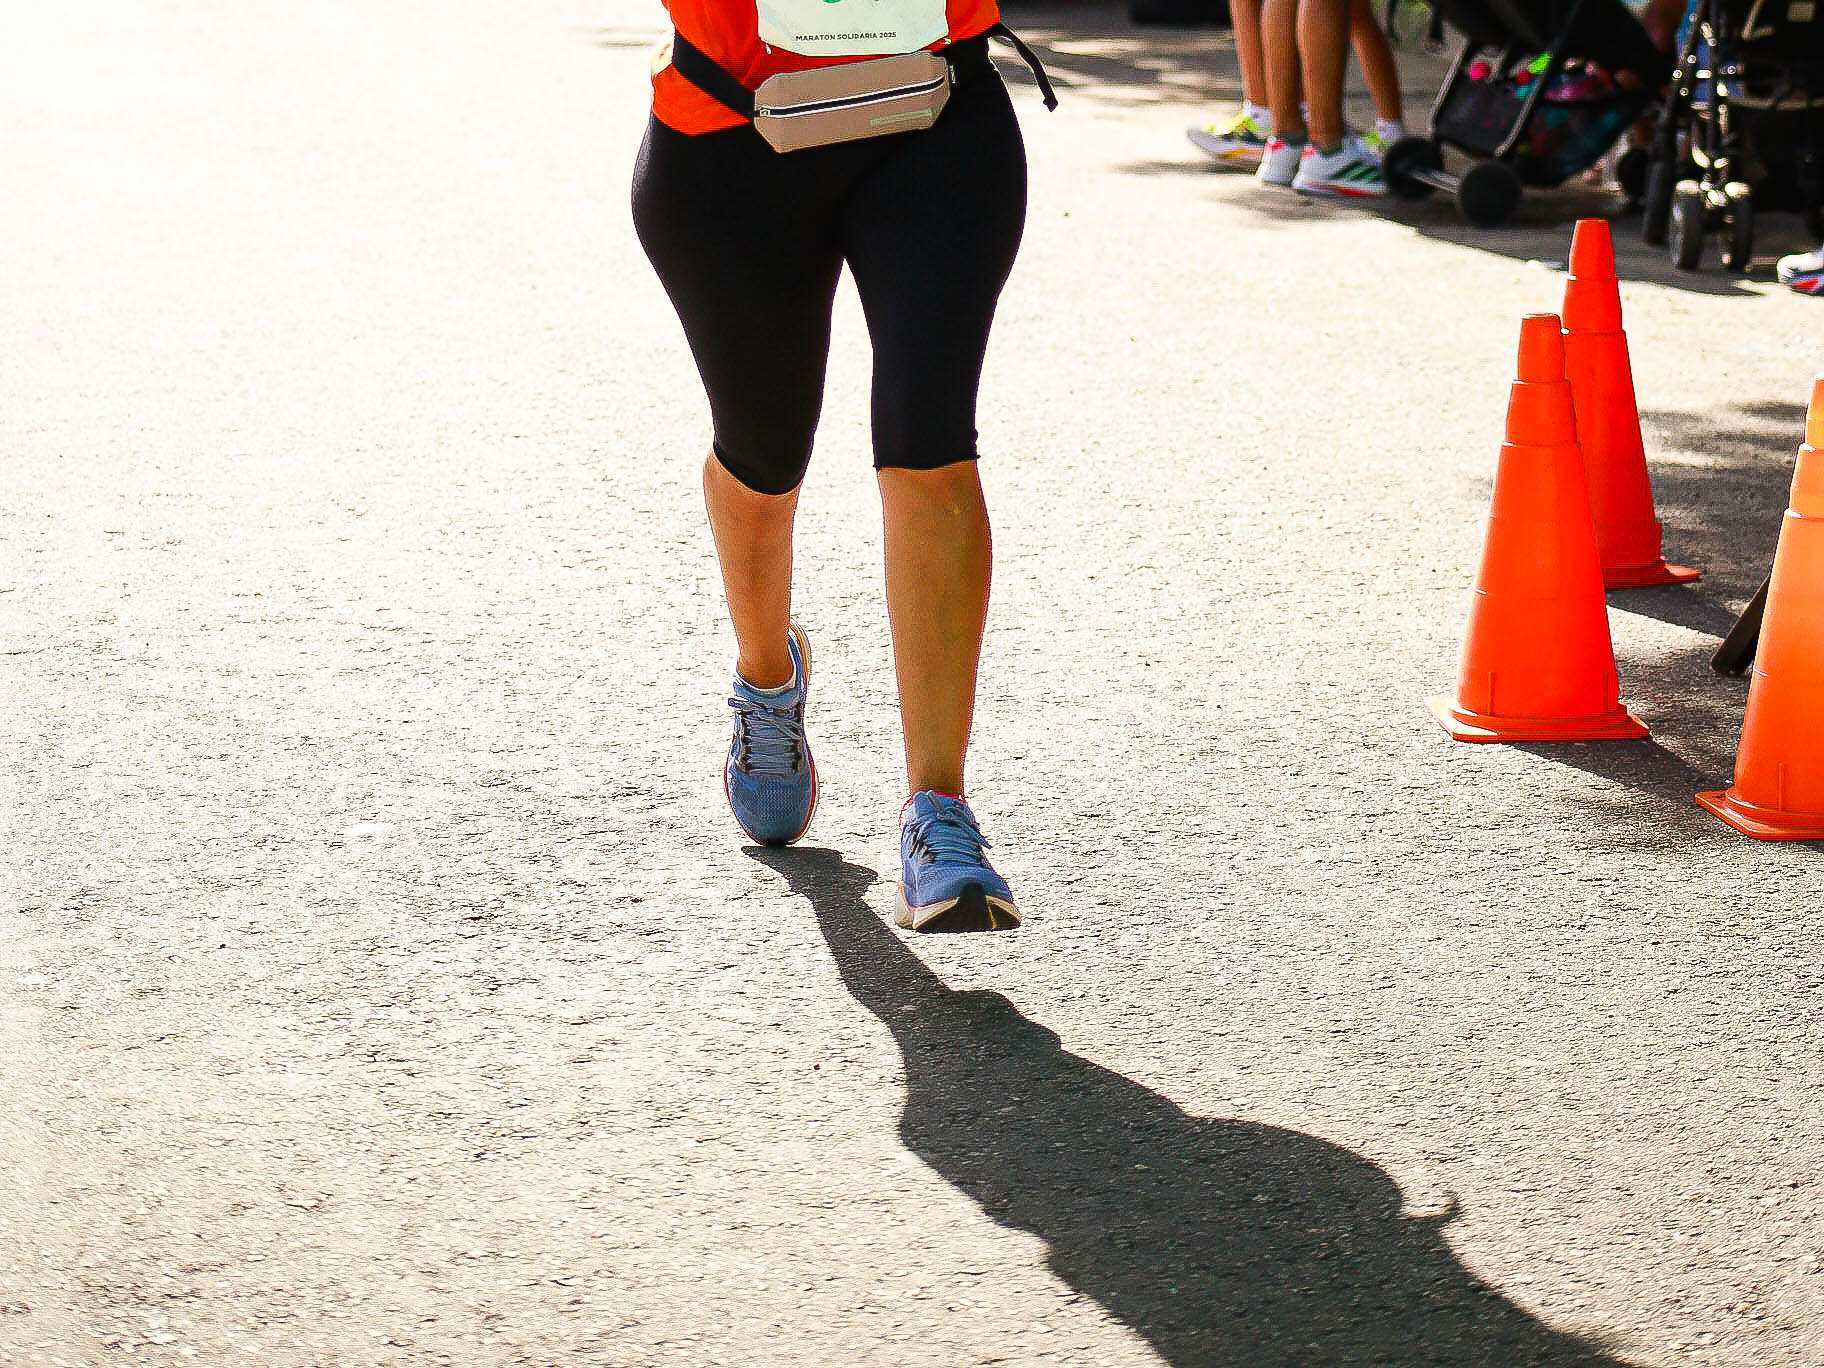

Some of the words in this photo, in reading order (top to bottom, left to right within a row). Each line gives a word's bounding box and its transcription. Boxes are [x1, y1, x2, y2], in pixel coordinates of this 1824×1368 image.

[795, 34, 836, 42] MARATON
[836, 32, 878, 41] SOLIDARIA
[878, 31, 897, 39] 2025
